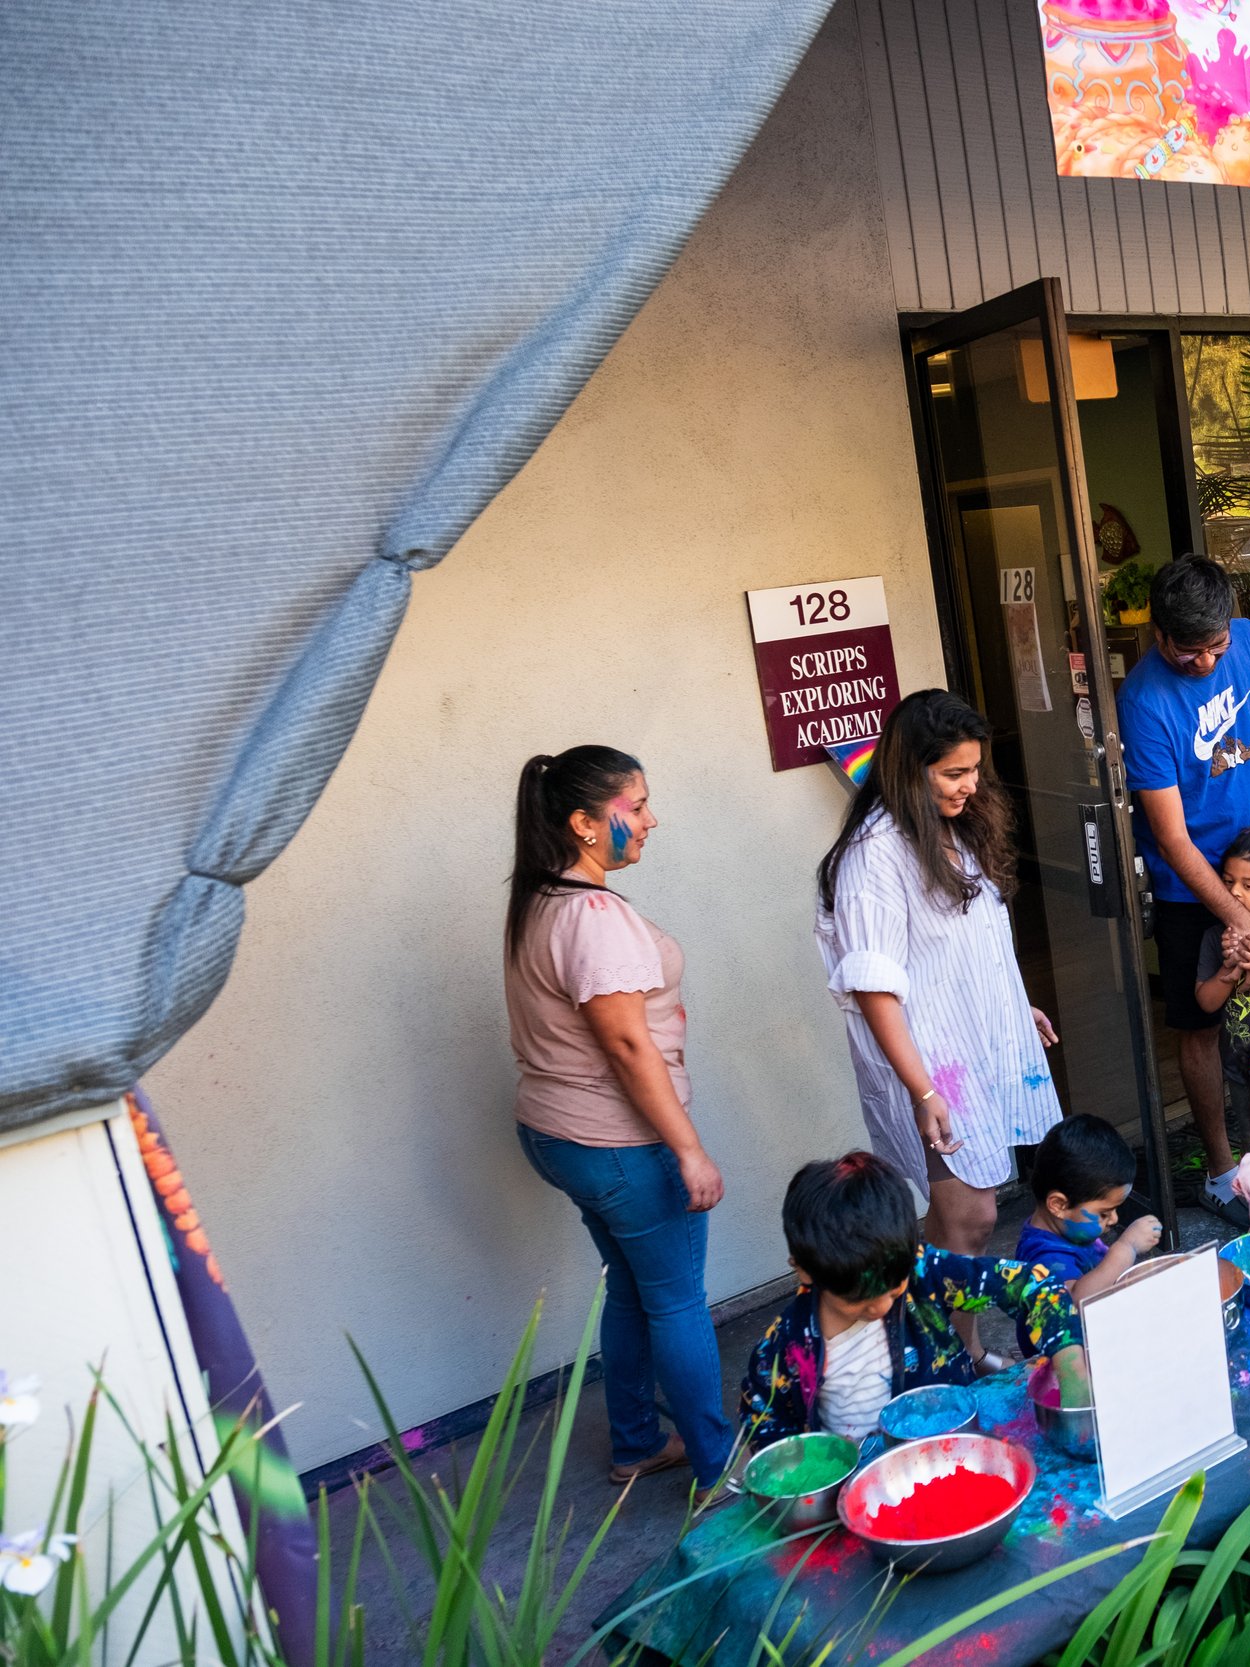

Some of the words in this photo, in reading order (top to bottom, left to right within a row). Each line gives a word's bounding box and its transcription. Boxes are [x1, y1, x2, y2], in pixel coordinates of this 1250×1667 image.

[1003, 569, 1034, 602] 128
[790, 590, 851, 626] 128
[790, 645, 868, 681] SCRIPPS
[779, 676, 887, 717] EXPLORING
[1197, 684, 1236, 737] NIKE
[796, 709, 883, 749] ACADEMY
[1088, 829, 1100, 877] PULL
